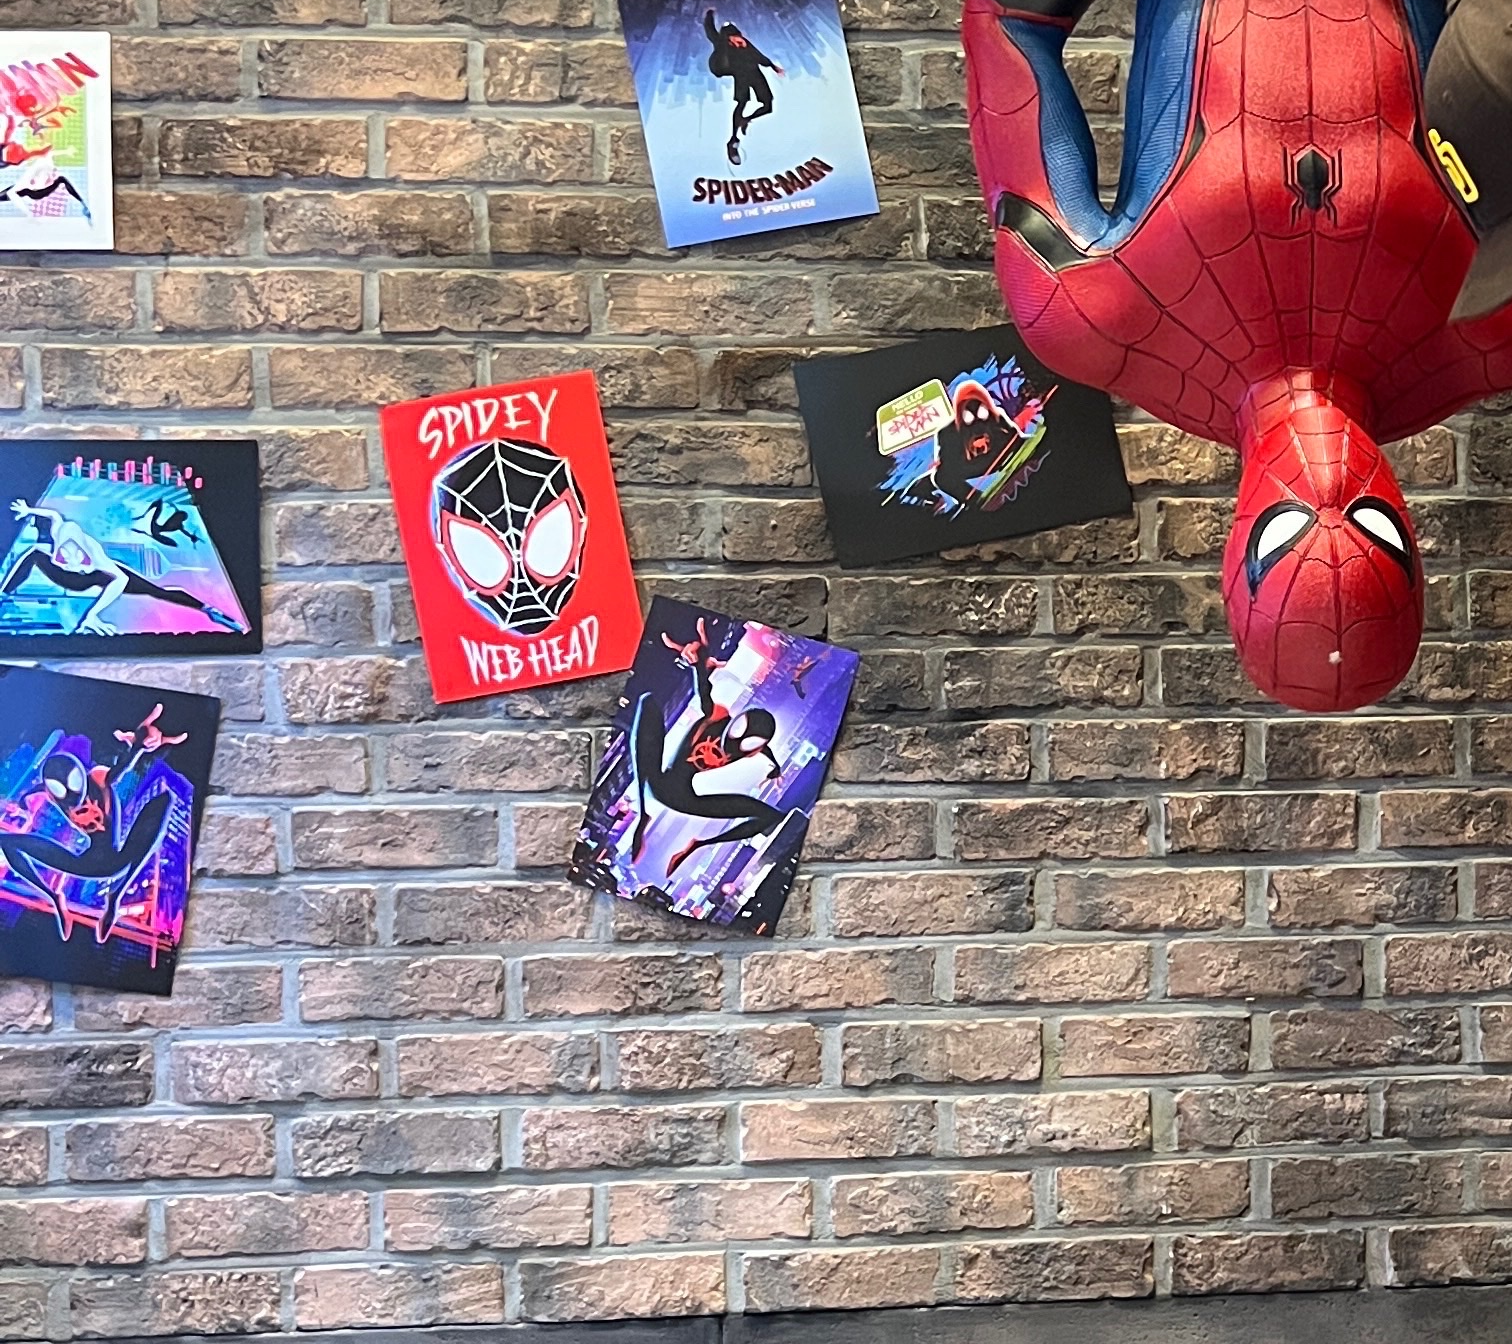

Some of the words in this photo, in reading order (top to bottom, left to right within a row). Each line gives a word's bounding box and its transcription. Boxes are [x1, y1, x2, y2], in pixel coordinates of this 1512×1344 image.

[692, 156, 834, 205] SPIDER-MAN
[722, 210, 743, 221] INTO
[744, 208, 760, 217] THE
[418, 388, 558, 459] SPIDEY
[460, 635, 524, 685] WEB
[528, 615, 600, 677] HEAD
